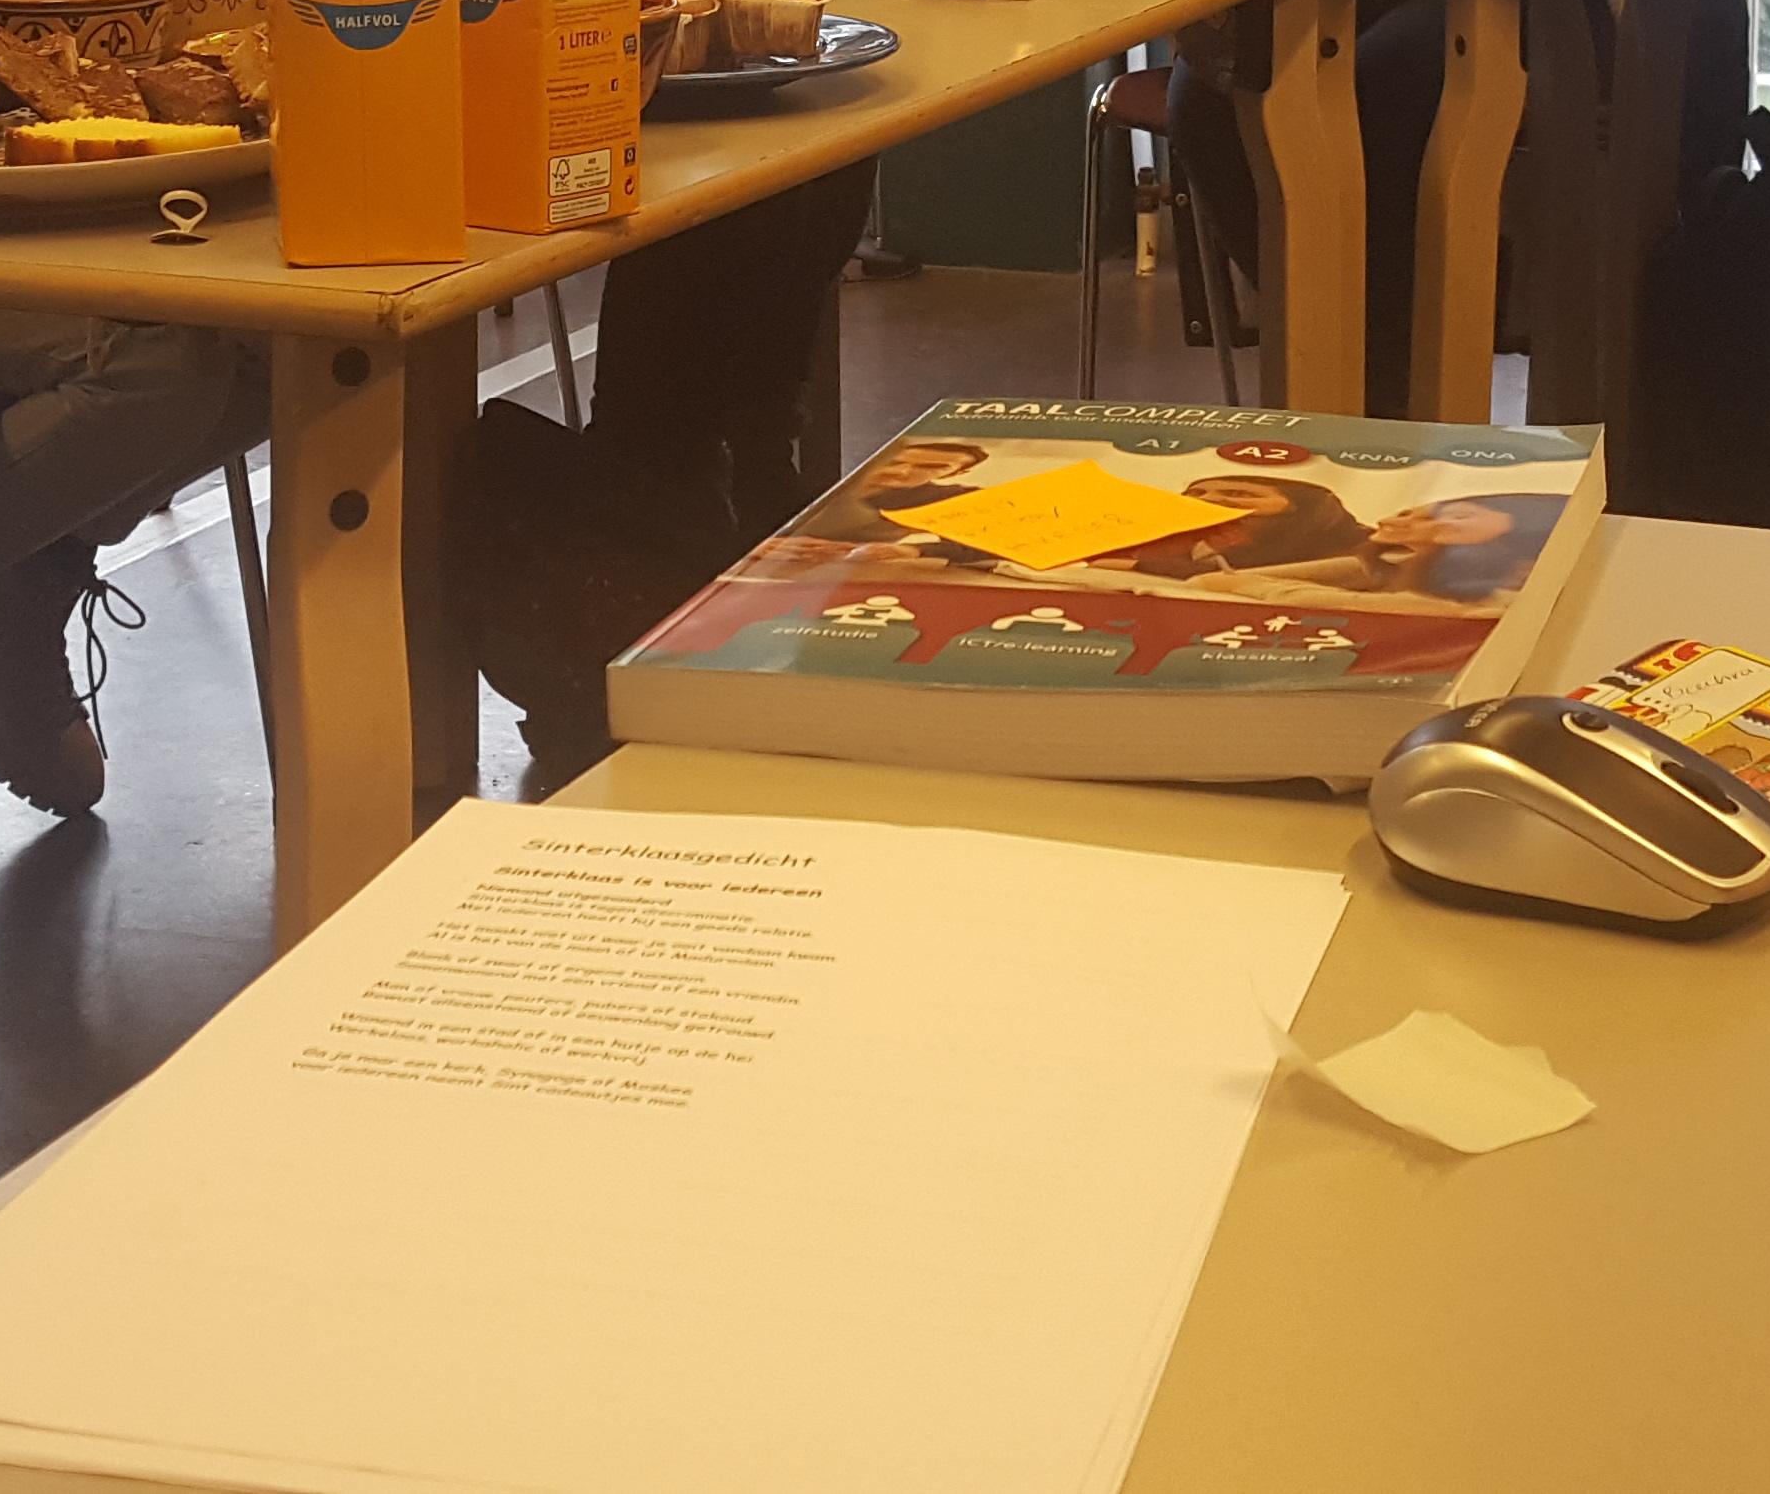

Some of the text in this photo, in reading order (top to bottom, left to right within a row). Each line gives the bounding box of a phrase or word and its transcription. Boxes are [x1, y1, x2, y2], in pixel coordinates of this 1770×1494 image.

[335, 14, 402, 30] HALFVOL
[559, 30, 599, 50] 1 LITER
[952, 402, 1312, 429] TAALCOMPLEET
[1136, 437, 1517, 464] A1 A2 KNM ONA
[772, 625, 879, 640] zelfstudie
[1201, 651, 1318, 663] klassikaal
[521, 839, 817, 868] Sinterklaasgedicht
[476, 883, 673, 907] Niemand uitgezonderd
[494, 865, 822, 899] Sinterklaas is voor iedereen
[457, 902, 813, 938] Met iedereen heeft hij een goede relatie
[468, 893, 755, 923] Sinterklaas is tegen discriminatie
[428, 930, 448, 939] Al
[471, 935, 501, 945] het
[506, 940, 535, 948] van
[539, 942, 562, 950] de
[615, 948, 639, 956] of
[641, 951, 666, 959] uit
[670, 952, 775, 969] Madurodam
[474, 927, 527, 937] maakt
[533, 931, 567, 939] niet
[571, 934, 596, 942] uit
[648, 939, 667, 949] je
[712, 946, 782, 958] vandaan
[787, 950, 836, 963] kwam
[405, 950, 451, 962] Blank
[457, 956, 479, 965] of
[483, 960, 534, 970] zwart
[538, 963, 561, 972] of
[564, 965, 626, 977] ergens
[373, 980, 410, 992] Man
[413, 985, 437, 994] of
[582, 1001, 648, 1013] pubers
[653, 1007, 675, 1016] of
[521, 974, 557, 982] met
[562, 977, 595, 986] een
[600, 979, 659, 993] vriend
[661, 984, 684, 994] of
[687, 987, 720, 998] een
[725, 991, 801, 1006] vriendin
[362, 990, 776, 1040] Bewust alleenstaand of eeuwenlang getrouwd
[341, 1011, 754, 1063] Wonend in een stad of in een hutje op de hei
[436, 1036, 535, 1053] workaholic
[539, 1044, 562, 1055] of
[302, 1046, 328, 1058] Ga
[329, 1051, 352, 1062] je
[356, 1054, 398, 1065] naar
[402, 1059, 438, 1069] een
[496, 1067, 587, 1086] Synagoge
[591, 1077, 615, 1087] of
[619, 1079, 693, 1096] Moskee
[337, 1066, 420, 1082] iedereen
[424, 1073, 485, 1088] neemt
[490, 1079, 529, 1092] Sint
[534, 1085, 643, 1104] cadeautjes
